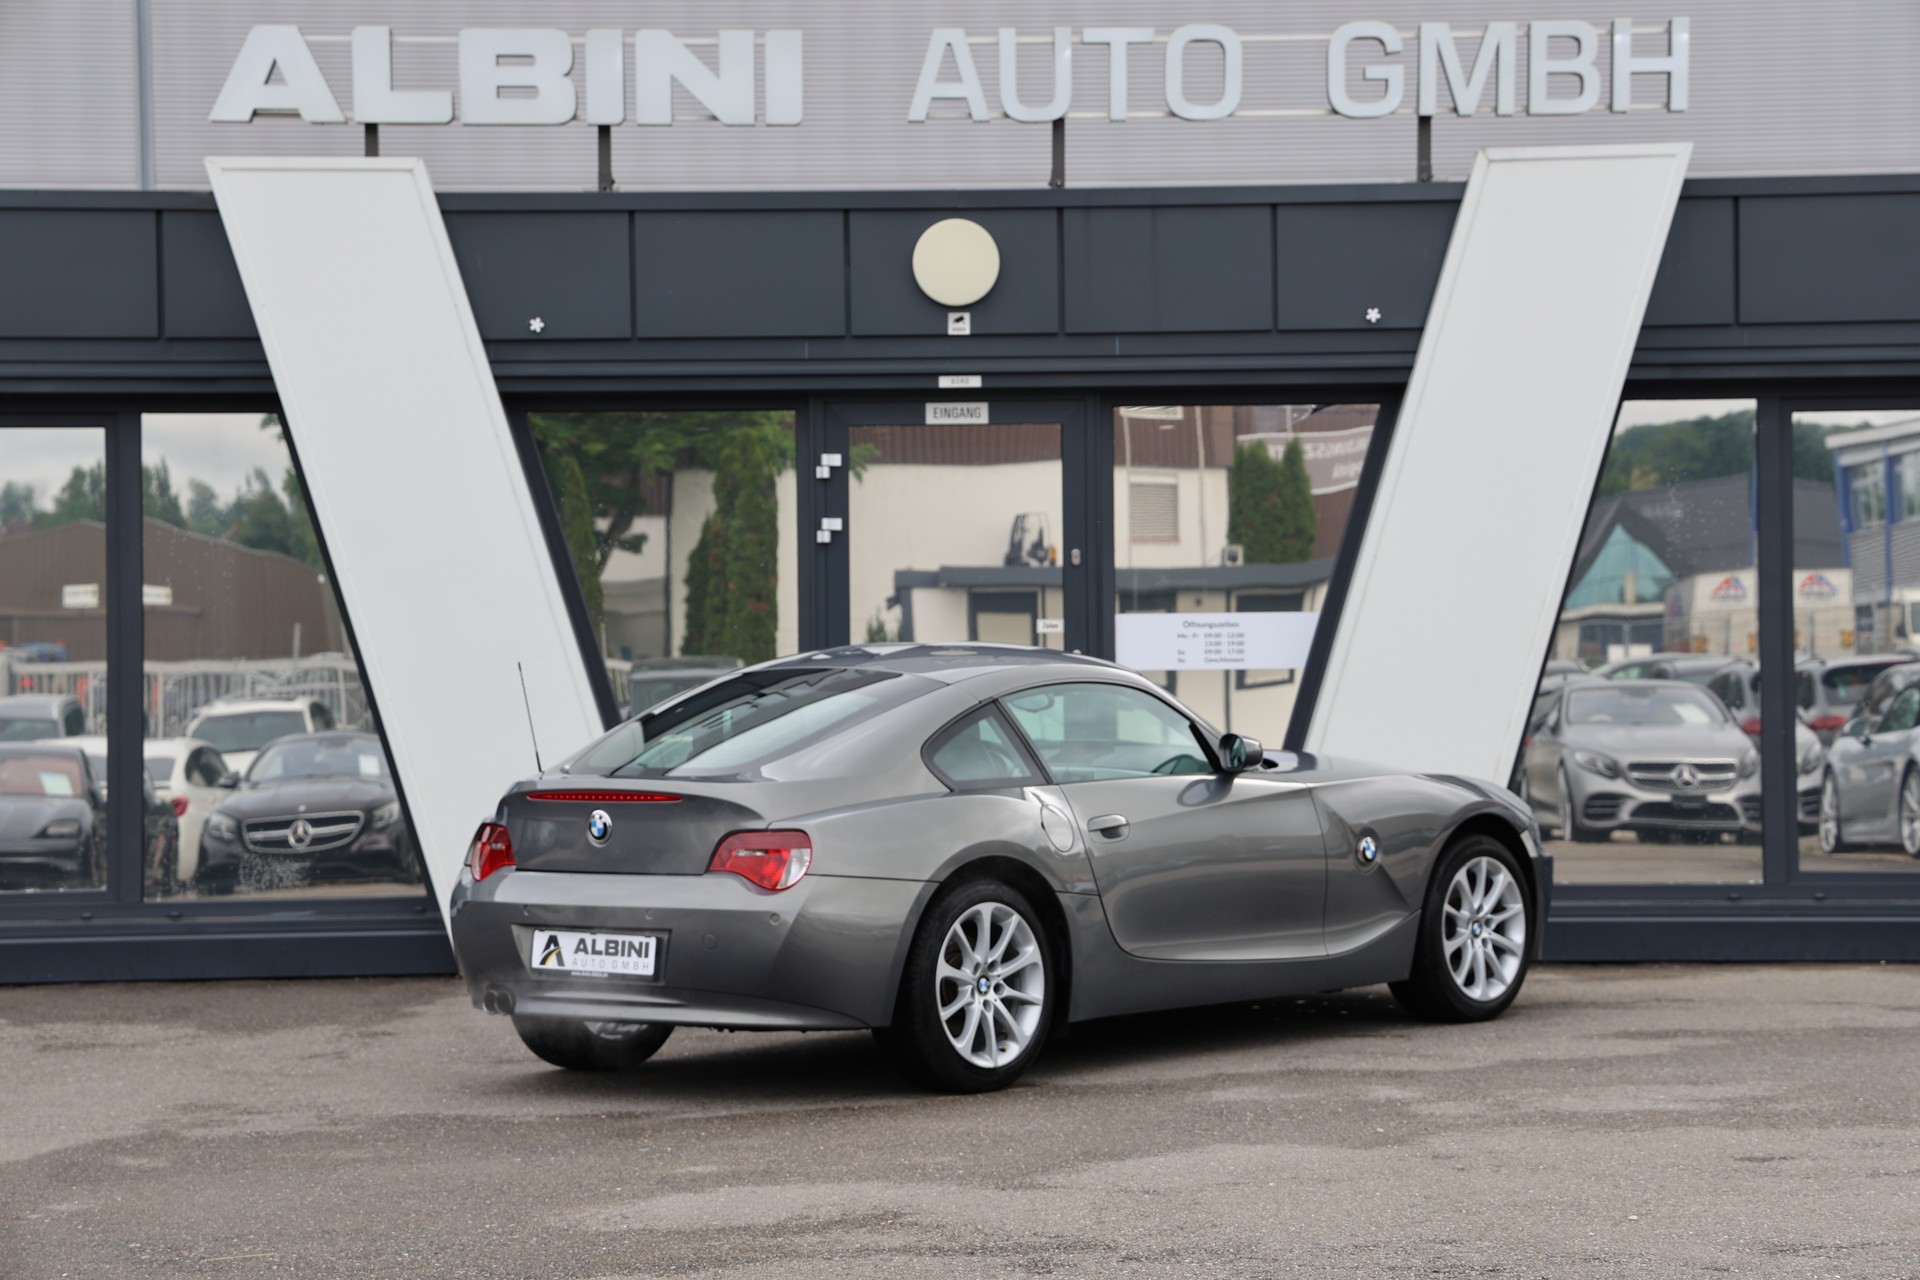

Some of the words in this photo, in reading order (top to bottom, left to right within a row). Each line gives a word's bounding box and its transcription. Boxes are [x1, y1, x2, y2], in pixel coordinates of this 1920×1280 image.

[208, 23, 803, 126] ALBINI
[907, 23, 1243, 123] AUTO
[1326, 17, 1690, 119] GMBH
[933, 406, 981, 419] EINGANG
[574, 938, 650, 958] ALBINI
[572, 958, 606, 969] AUTO
[611, 961, 650, 972] GMBH
